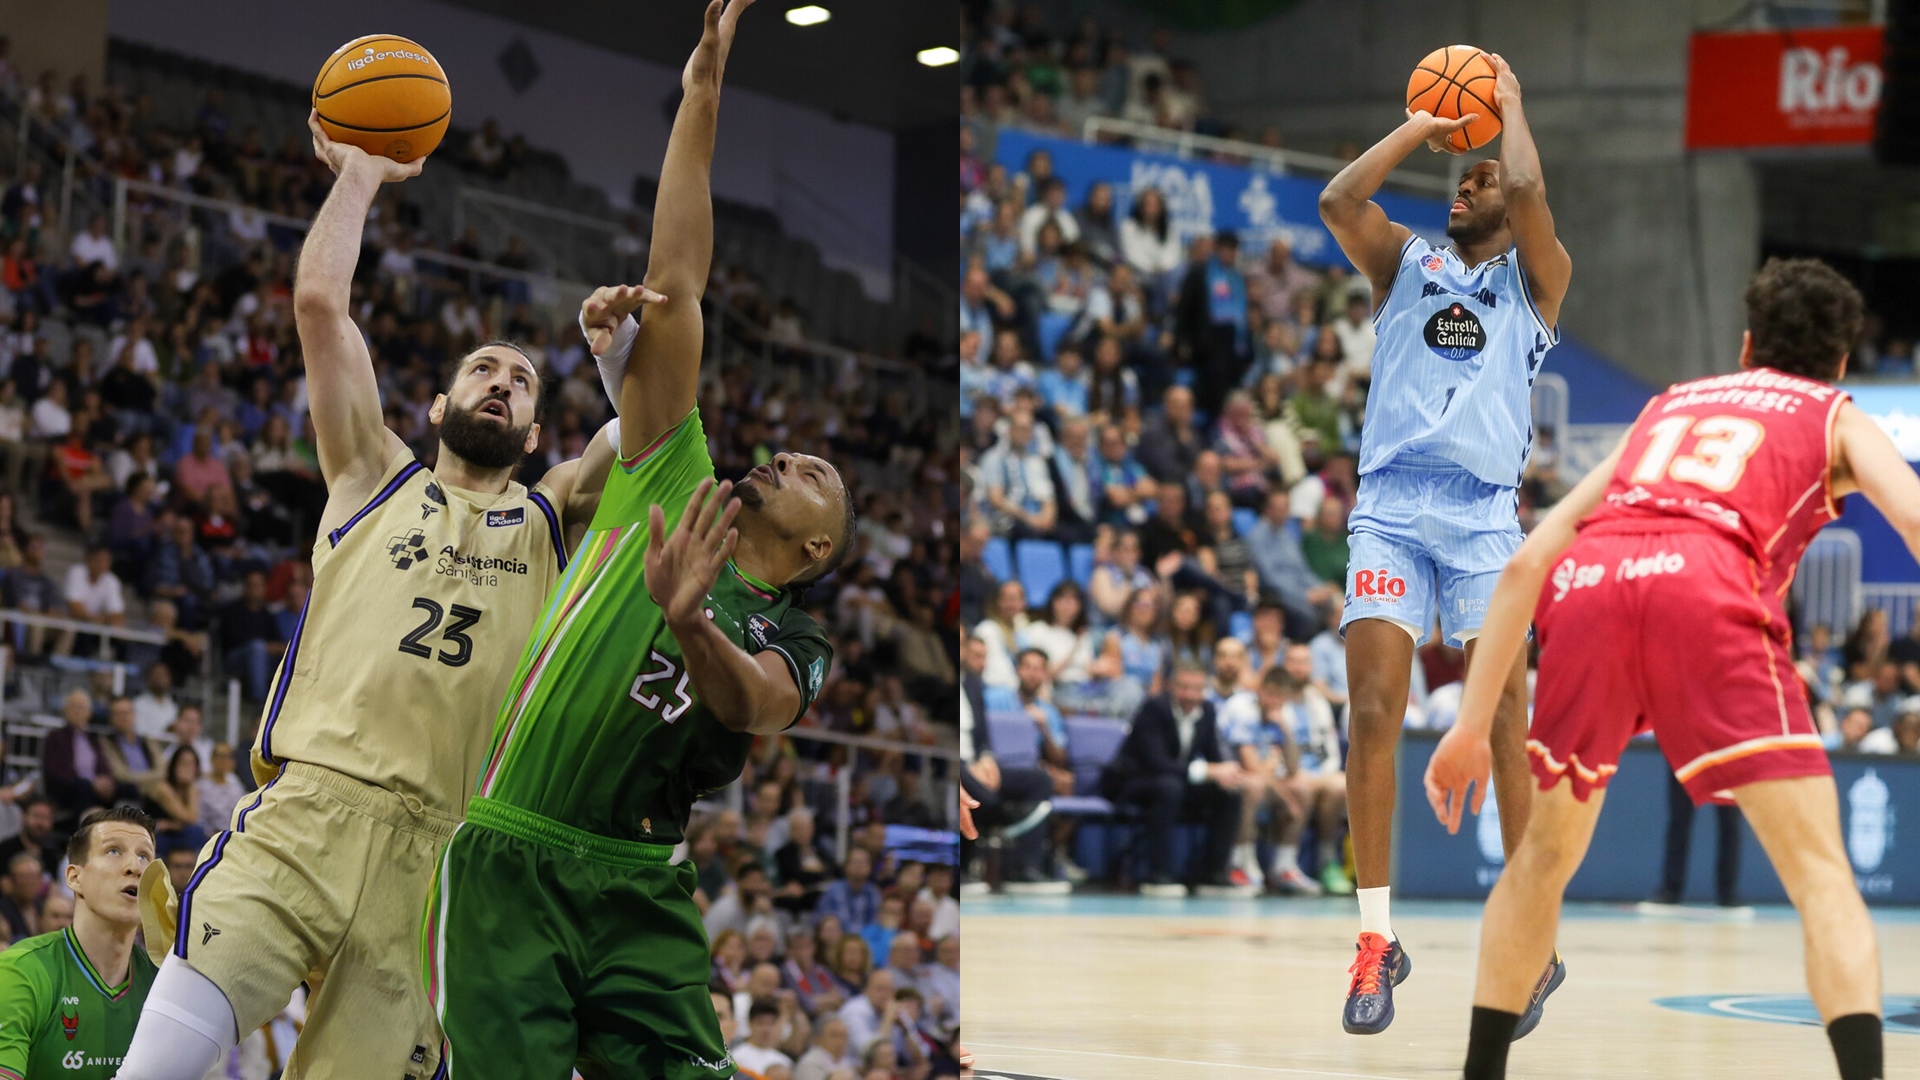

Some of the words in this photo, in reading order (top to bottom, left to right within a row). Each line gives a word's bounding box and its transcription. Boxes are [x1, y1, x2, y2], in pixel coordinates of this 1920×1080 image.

[347, 52, 375, 71] liga
[375, 49, 430, 64] endesa
[1436, 317, 1479, 333] Estrella
[1437, 331, 1477, 347] Galicia
[1630, 414, 1766, 493] 13
[489, 517, 522, 526] endesa
[398, 597, 483, 668] 23
[629, 650, 693, 725] 25
[62, 1050, 86, 1070] 65
[86, 1057, 122, 1066] ANIVE
